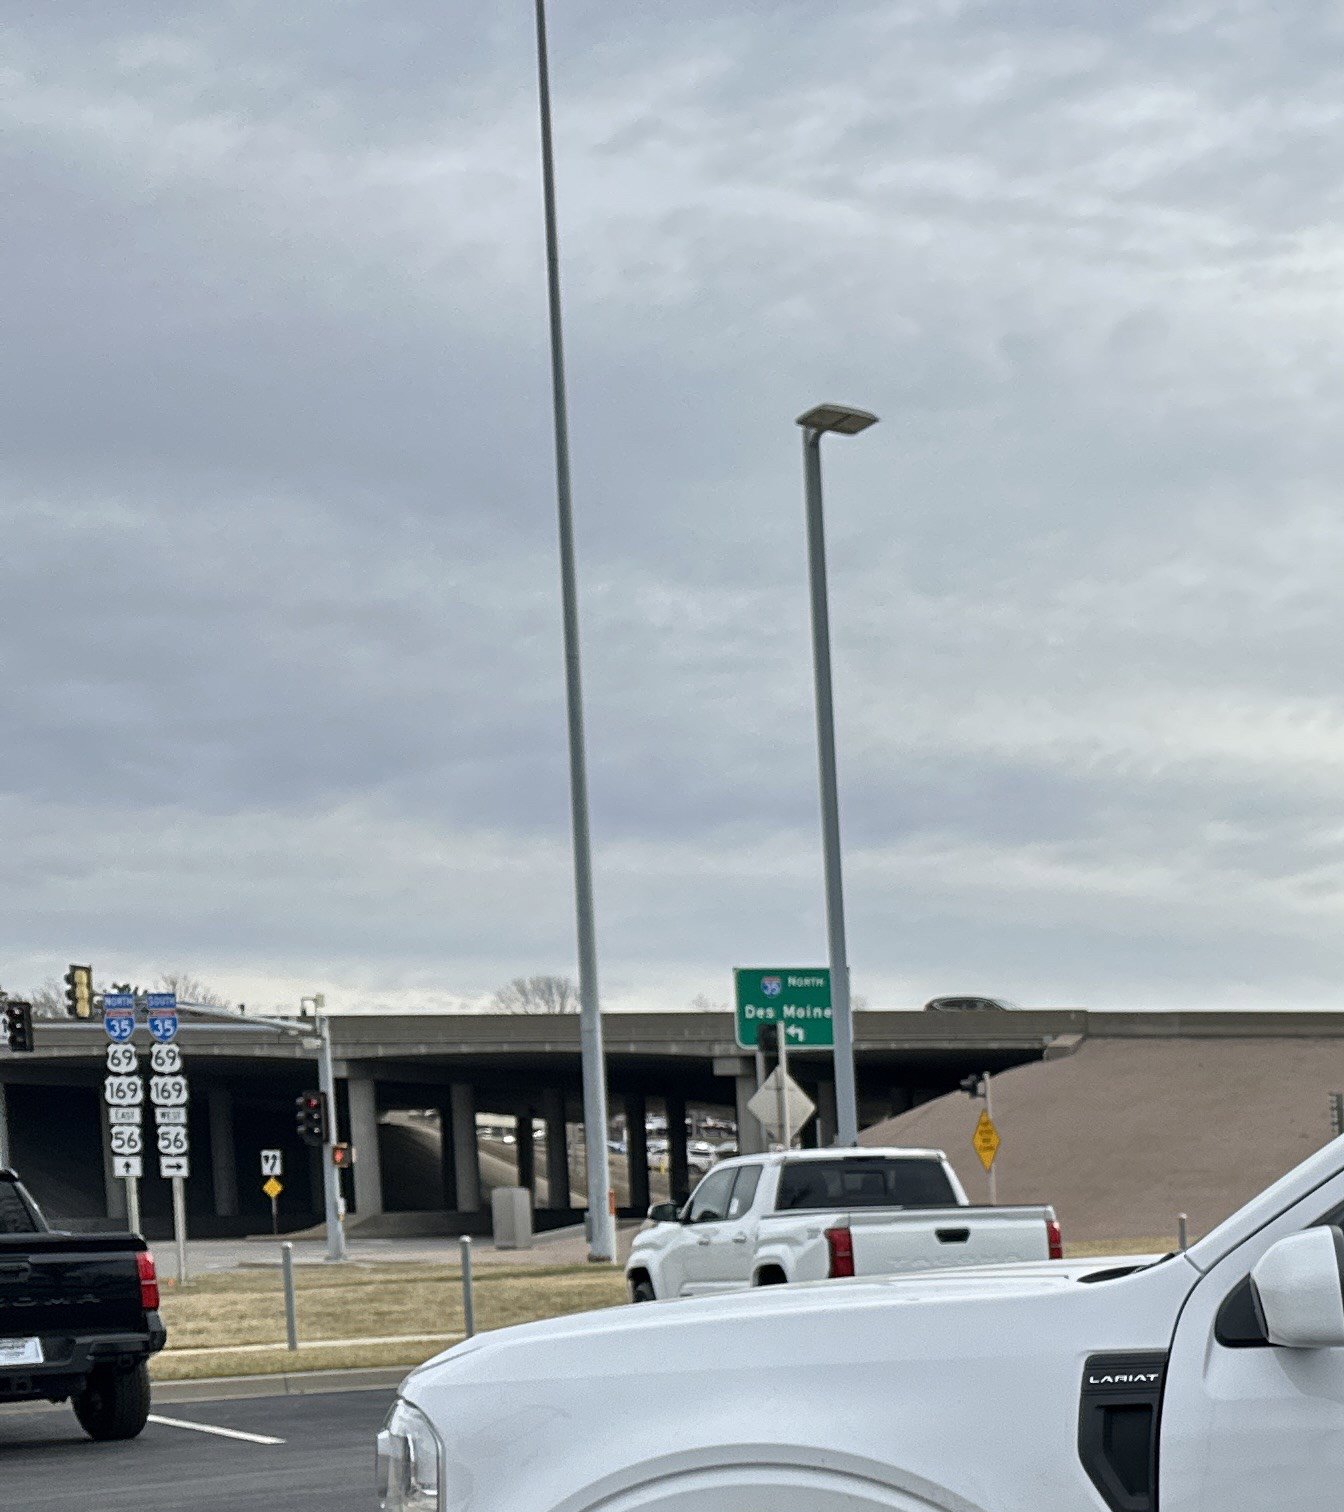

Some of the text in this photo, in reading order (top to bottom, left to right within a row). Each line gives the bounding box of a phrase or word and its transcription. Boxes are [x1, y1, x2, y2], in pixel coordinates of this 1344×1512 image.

[787, 976, 824, 987] NORTH
[744, 1004, 832, 1019] Des Moine
[110, 1019, 131, 1037] 35
[153, 1019, 174, 1037] 35
[111, 1049, 133, 1067] 69
[155, 1049, 177, 1067] 69
[109, 1082, 138, 1099] 169
[154, 1081, 183, 1099] 169
[115, 1110, 135, 1120] EAST
[160, 1110, 181, 1120] WEST
[114, 1131, 137, 1149] 56
[160, 1131, 183, 1149] 56
[1089, 1373, 1159, 1384] LARIAT
